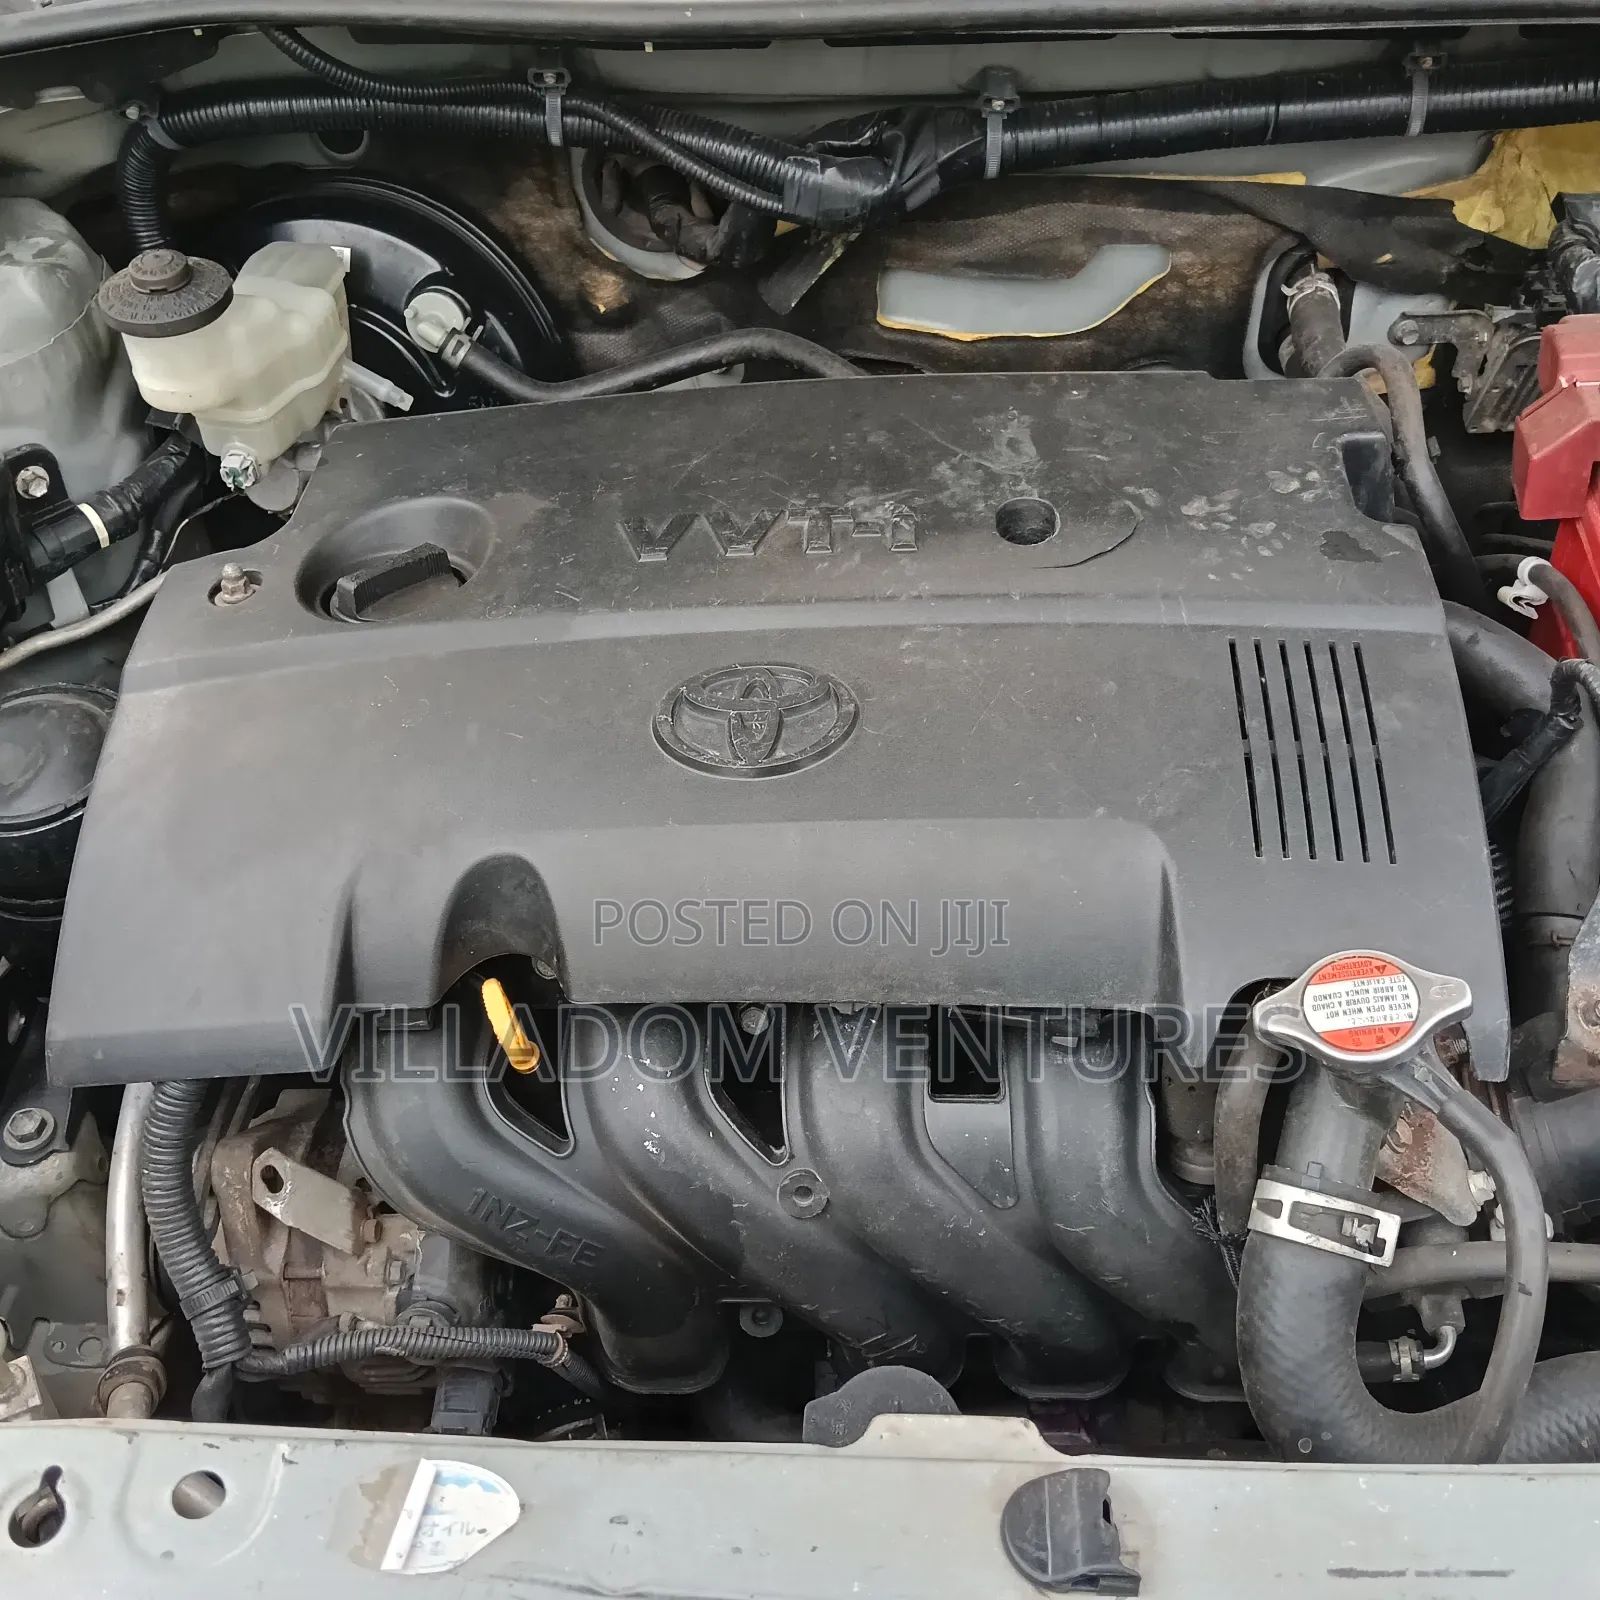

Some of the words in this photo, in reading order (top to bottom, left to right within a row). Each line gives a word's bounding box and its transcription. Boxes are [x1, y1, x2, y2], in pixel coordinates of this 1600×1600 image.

[1331, 960, 1372, 971] ADVERTENCIA
[1318, 968, 1374, 981] AVERTISSEMENT
[1352, 978, 1385, 987] CALIENTE
[1345, 988, 1369, 997] NUNCA
[1373, 986, 1394, 994] ABRIR
[1398, 984, 1407, 992] NO
[1313, 992, 1342, 1002] CUANDO
[1373, 995, 1398, 1004] JAMAIS
[1400, 993, 1409, 1001] NE
[1312, 1002, 1335, 1011] CHAUD
[1345, 997, 1370, 1007] OUVRIR
[1385, 1002, 1411, 1011] NEVER
[1342, 1007, 1363, 1017] WHEN
[1366, 1005, 1385, 1014] OPEN
[1326, 1010, 1339, 1019] HOT
[1348, 1027, 1384, 1037] WARNING
